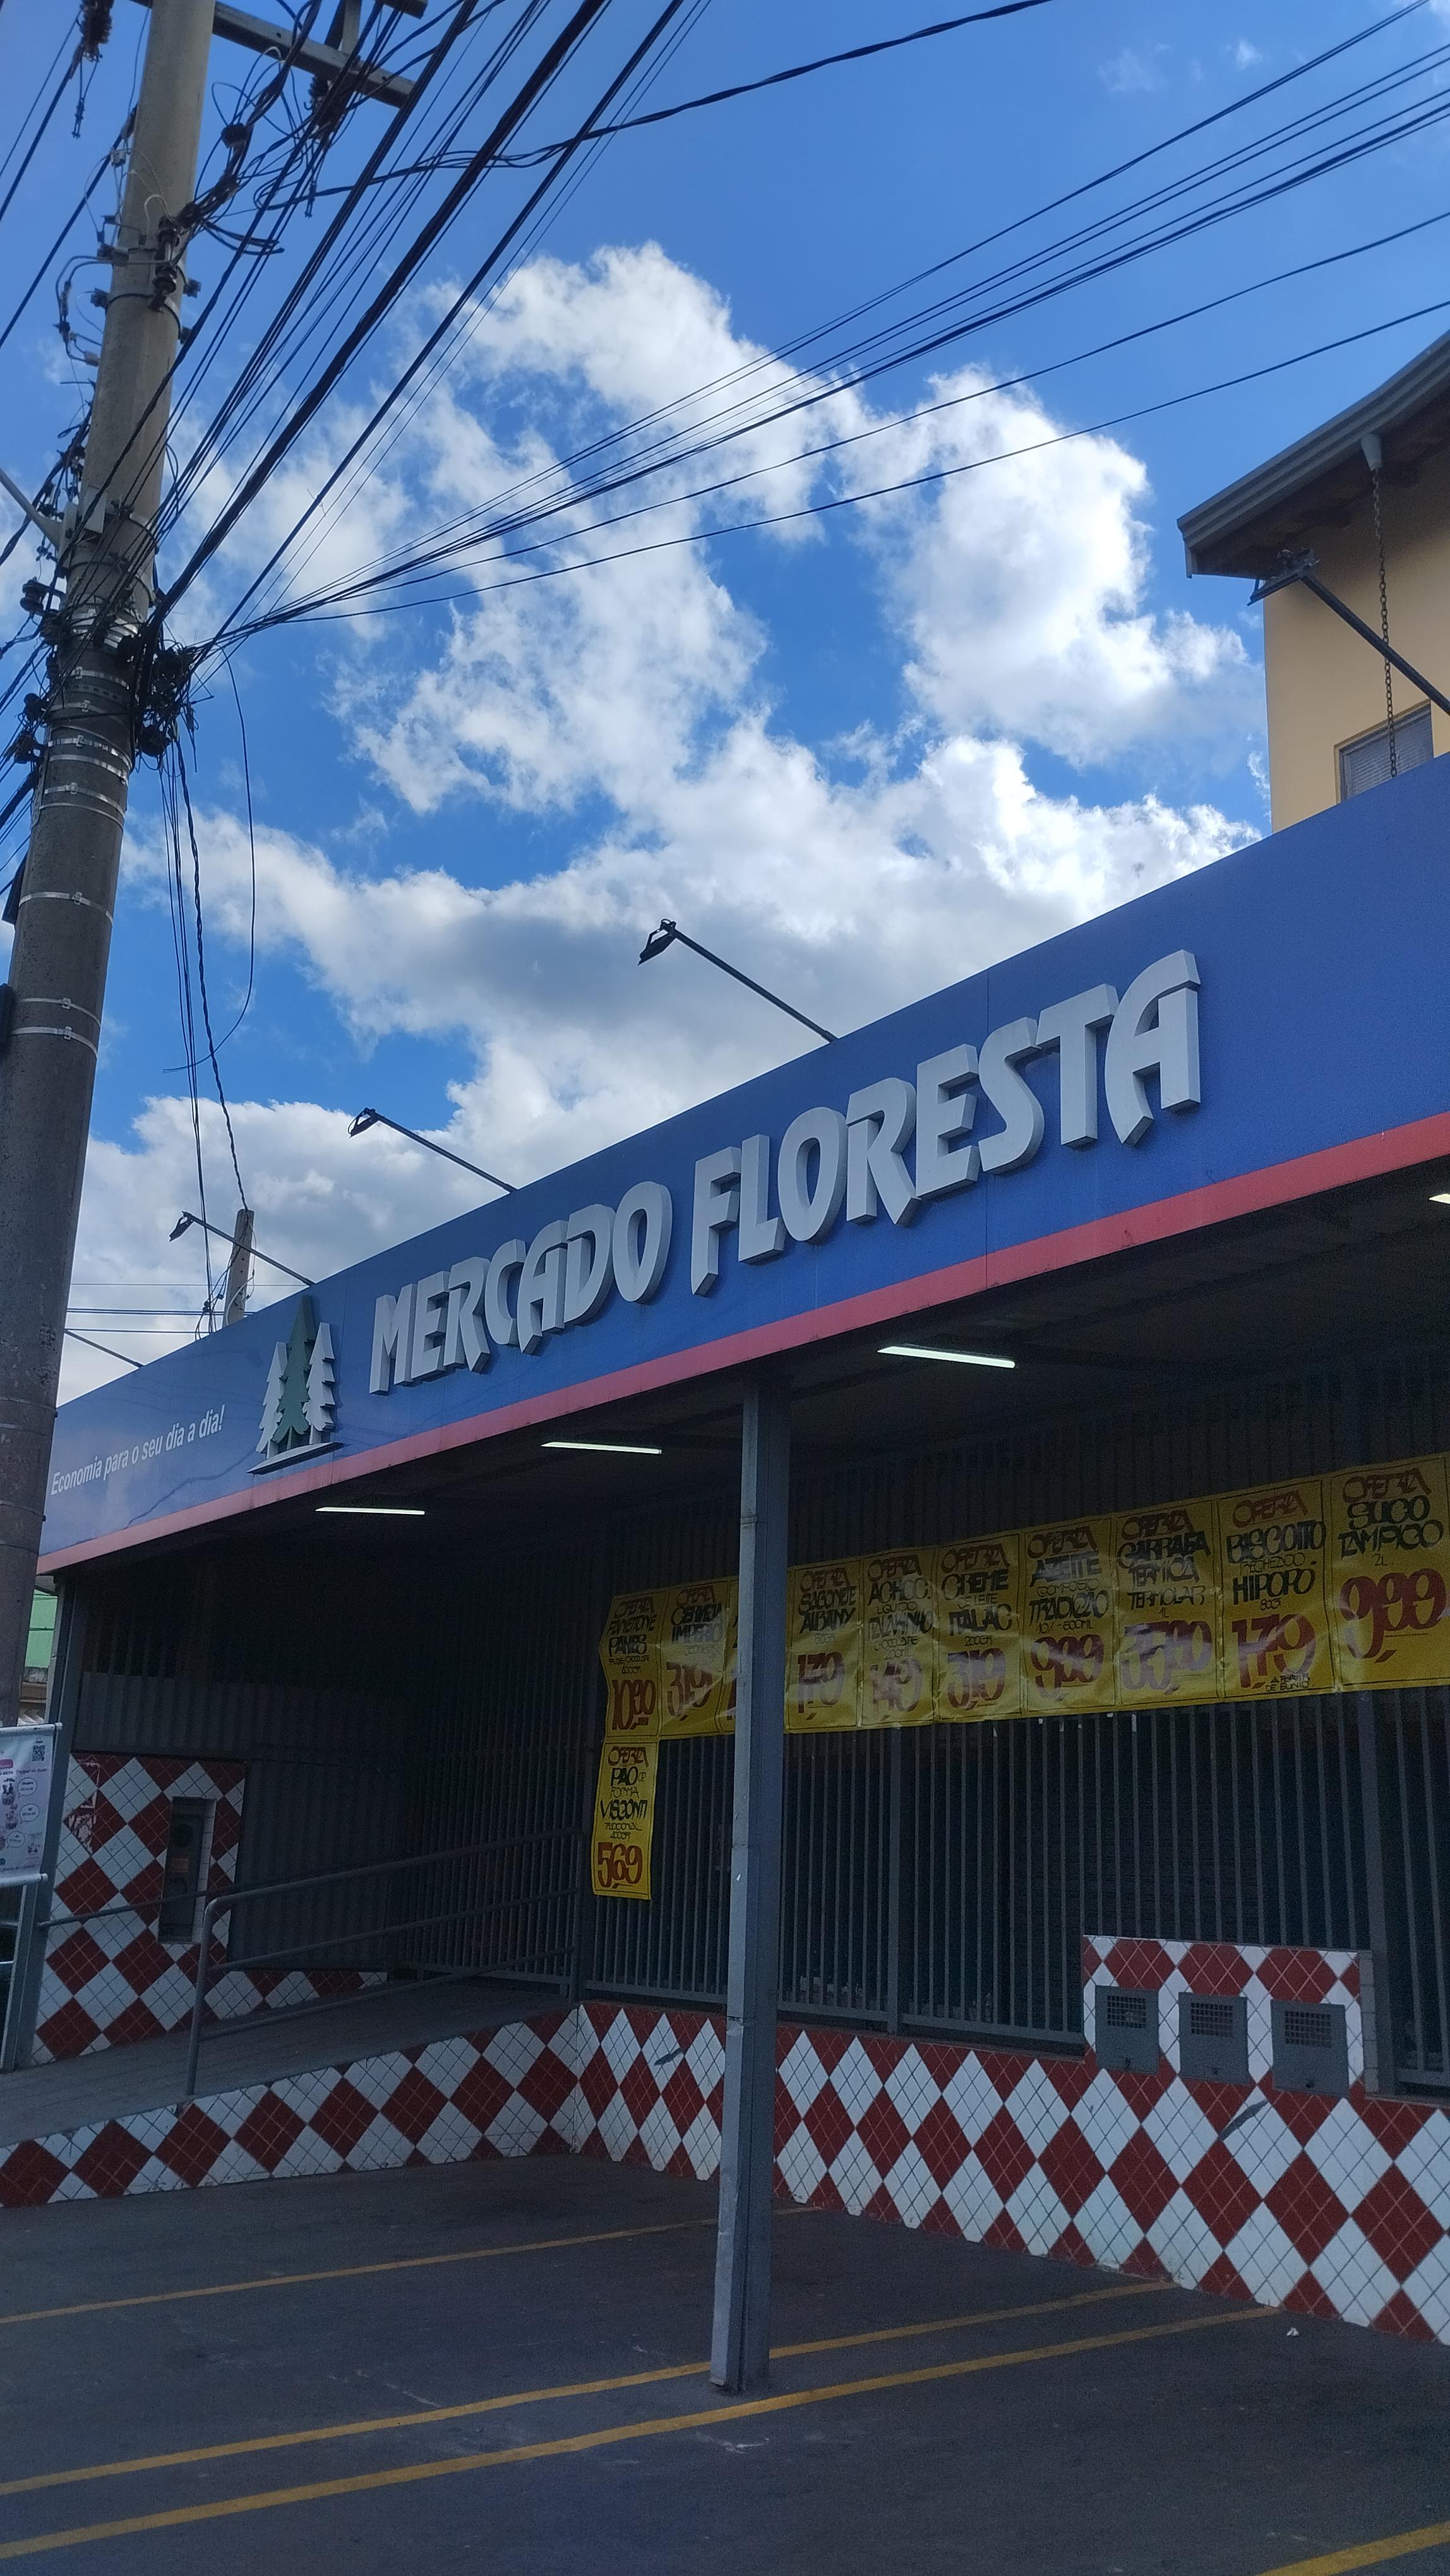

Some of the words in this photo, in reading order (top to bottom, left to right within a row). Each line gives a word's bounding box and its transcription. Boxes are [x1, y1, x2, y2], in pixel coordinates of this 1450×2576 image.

[369, 1181, 673, 1396] MERCADO
[691, 949, 1201, 1297] FLORESTA
[51, 1456, 103, 1496] Economia
[103, 1448, 129, 1481] para
[131, 1446, 138, 1465] o
[141, 1434, 162, 1461] seu
[165, 1422, 184, 1451] dia
[188, 1422, 196, 1443] a
[199, 1404, 225, 1439] dia!
[1343, 1468, 1432, 1503] OFERTA
[1122, 1509, 1195, 1540] OFERTA
[1232, 1489, 1308, 1528] OFERTA
[1347, 1494, 1430, 1530] SUCO
[1028, 1526, 1098, 1558] OFERTA
[1226, 1519, 1326, 1564] BISCOITO
[1338, 1519, 1444, 1561] TAMPICO
[868, 1554, 922, 1582] OFERTA
[941, 1543, 1010, 1573] OFERTA
[1030, 1550, 1103, 1587] AZEITE
[1374, 1553, 1388, 1566] 2L
[676, 1585, 716, 1606] OFERTA
[800, 1568, 849, 1593] OFERTA
[942, 1569, 1008, 1601] CREME
[949, 1604, 1012, 1636] ITALAC
[608, 1746, 649, 1767] OFERTA
[601, 1799, 648, 1820] VISCONTI
